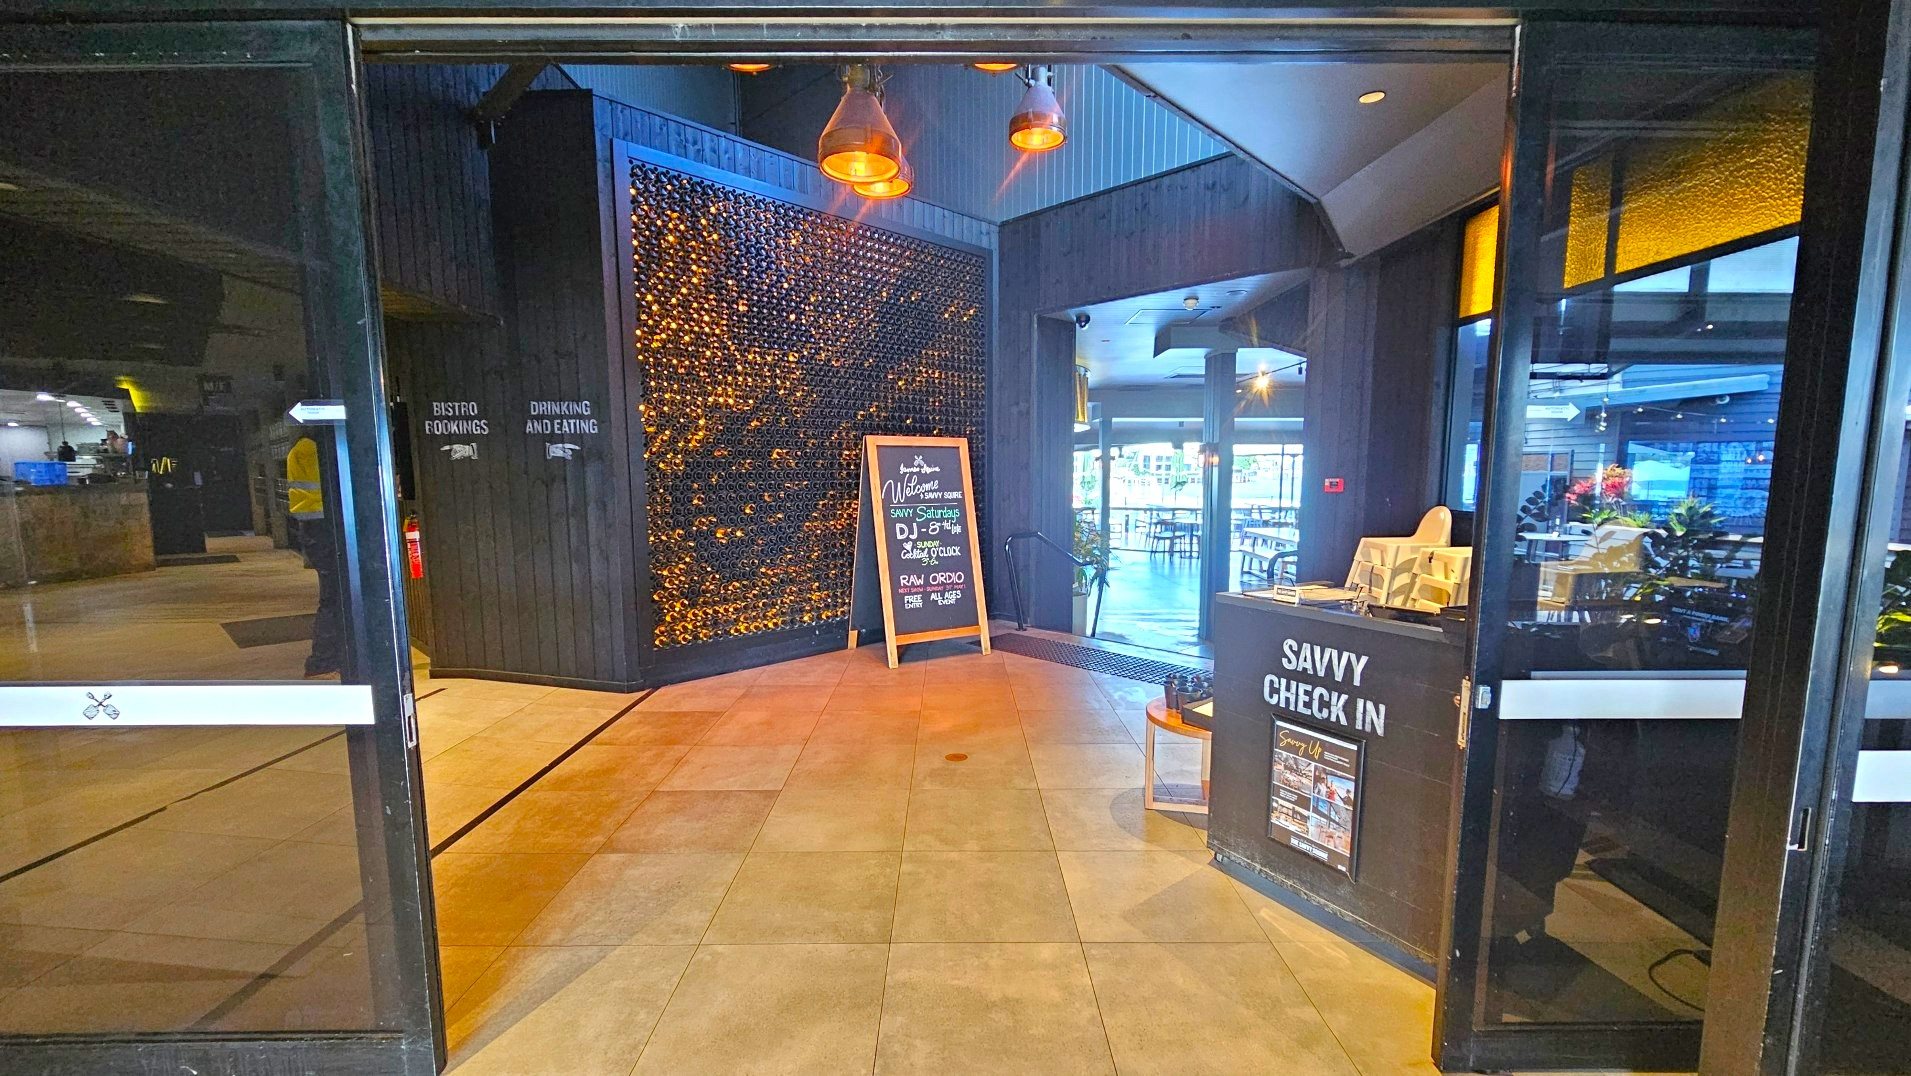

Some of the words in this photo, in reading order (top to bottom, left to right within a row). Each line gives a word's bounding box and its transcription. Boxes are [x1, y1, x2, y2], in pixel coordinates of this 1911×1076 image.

[432, 402, 478, 416] BISTRO
[530, 401, 591, 415] DRINKING
[425, 420, 489, 435] BOOKINGS
[526, 420, 551, 434] AND
[554, 419, 598, 434] EATING
[882, 473, 939, 503] Welcome
[891, 508, 913, 518] SAVVY
[916, 506, 960, 523] Saturdays
[895, 522, 918, 539] DJ
[916, 540, 940, 548] SUNDAY
[900, 574, 925, 586] RAW
[929, 571, 964, 585] ORDIO
[904, 594, 922, 603] FREE
[930, 592, 943, 600] ALL
[944, 590, 962, 600] AGES
[1282, 638, 1369, 687] SAVVY
[1263, 674, 1349, 726] CHECK
[1355, 698, 1386, 737] IN
[1279, 730, 1307, 757] Savvy
[1308, 740, 1323, 760] Up
